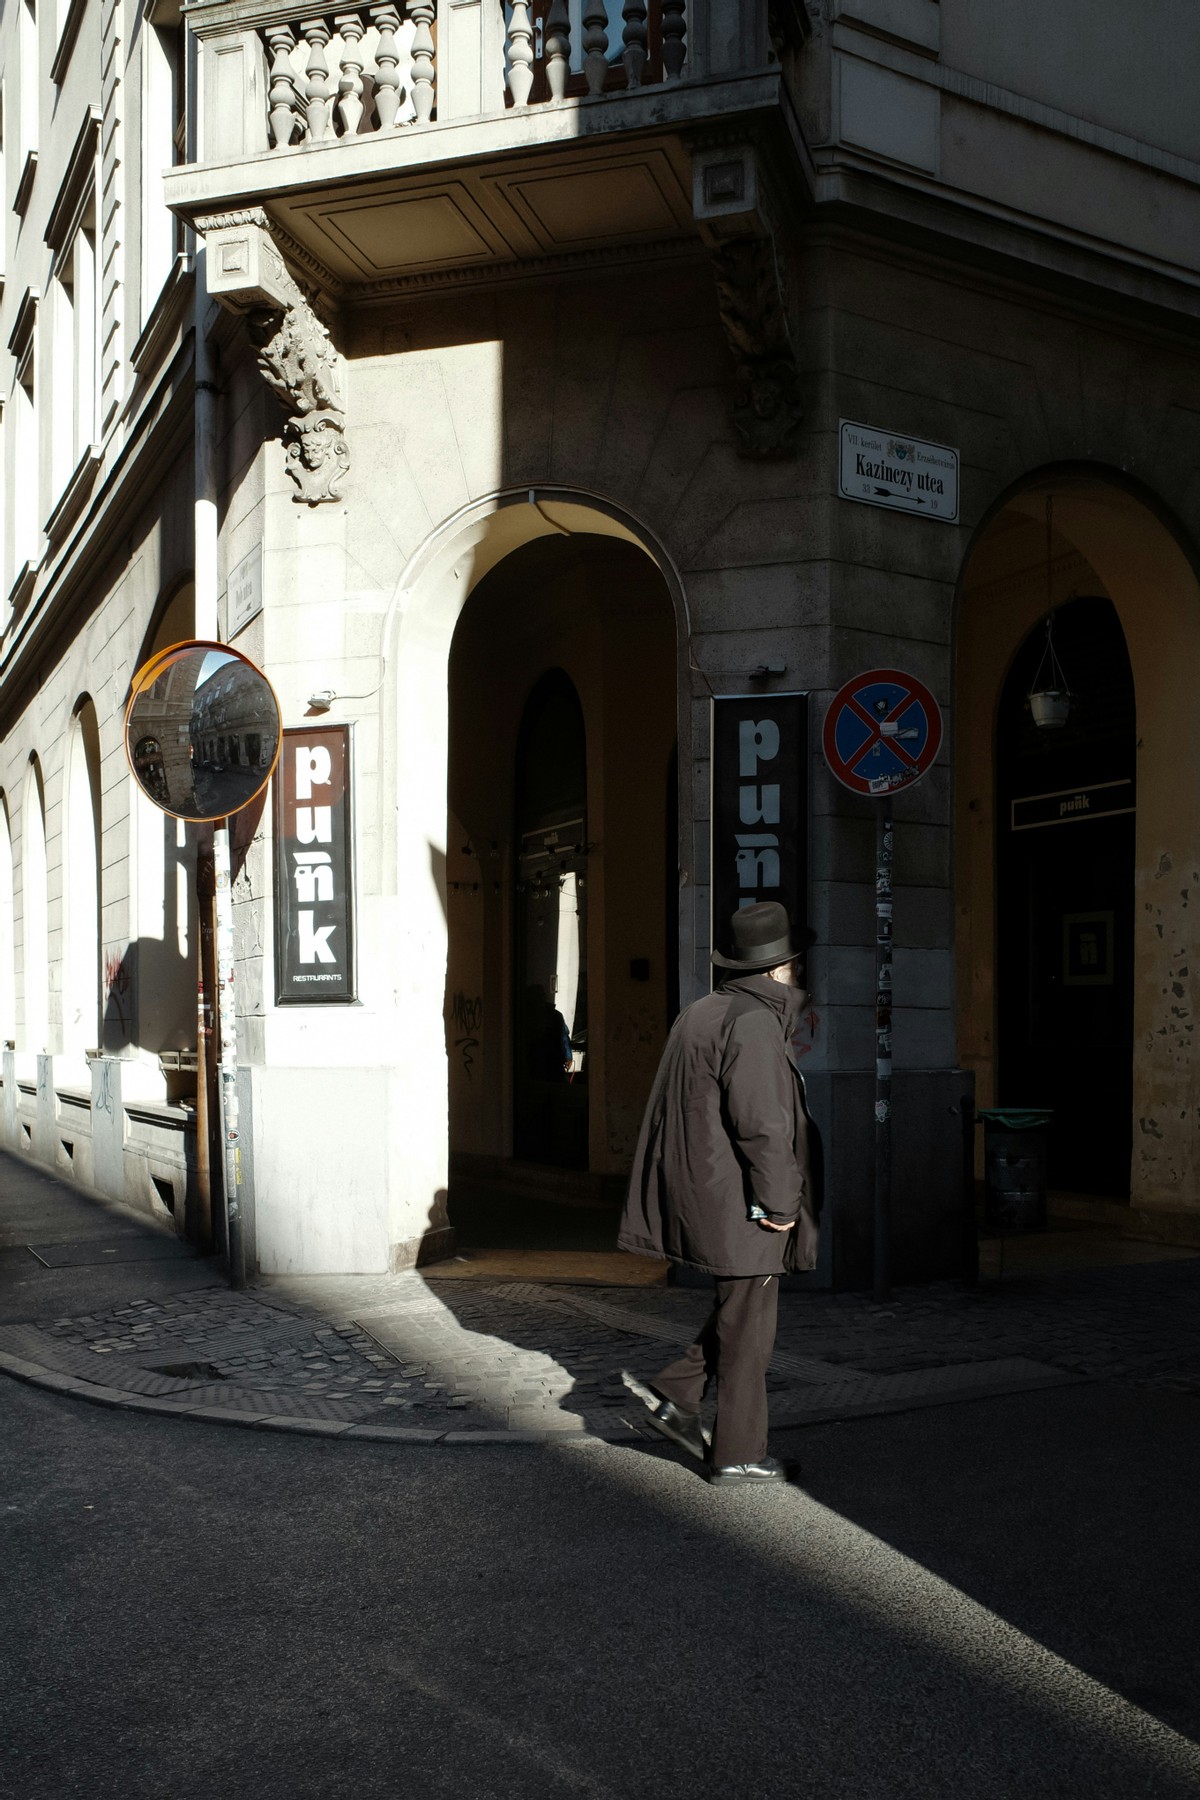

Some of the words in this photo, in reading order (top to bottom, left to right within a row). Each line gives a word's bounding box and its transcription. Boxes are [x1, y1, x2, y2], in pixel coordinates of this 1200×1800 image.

[848, 434, 859, 446] VII.
[861, 437, 882, 452] kerület
[856, 453, 914, 492] Kazinczy
[917, 472, 944, 495] utca
[862, 483, 871, 494] 33
[930, 500, 938, 509] 19
[292, 973, 342, 982] RESTAURANTS
